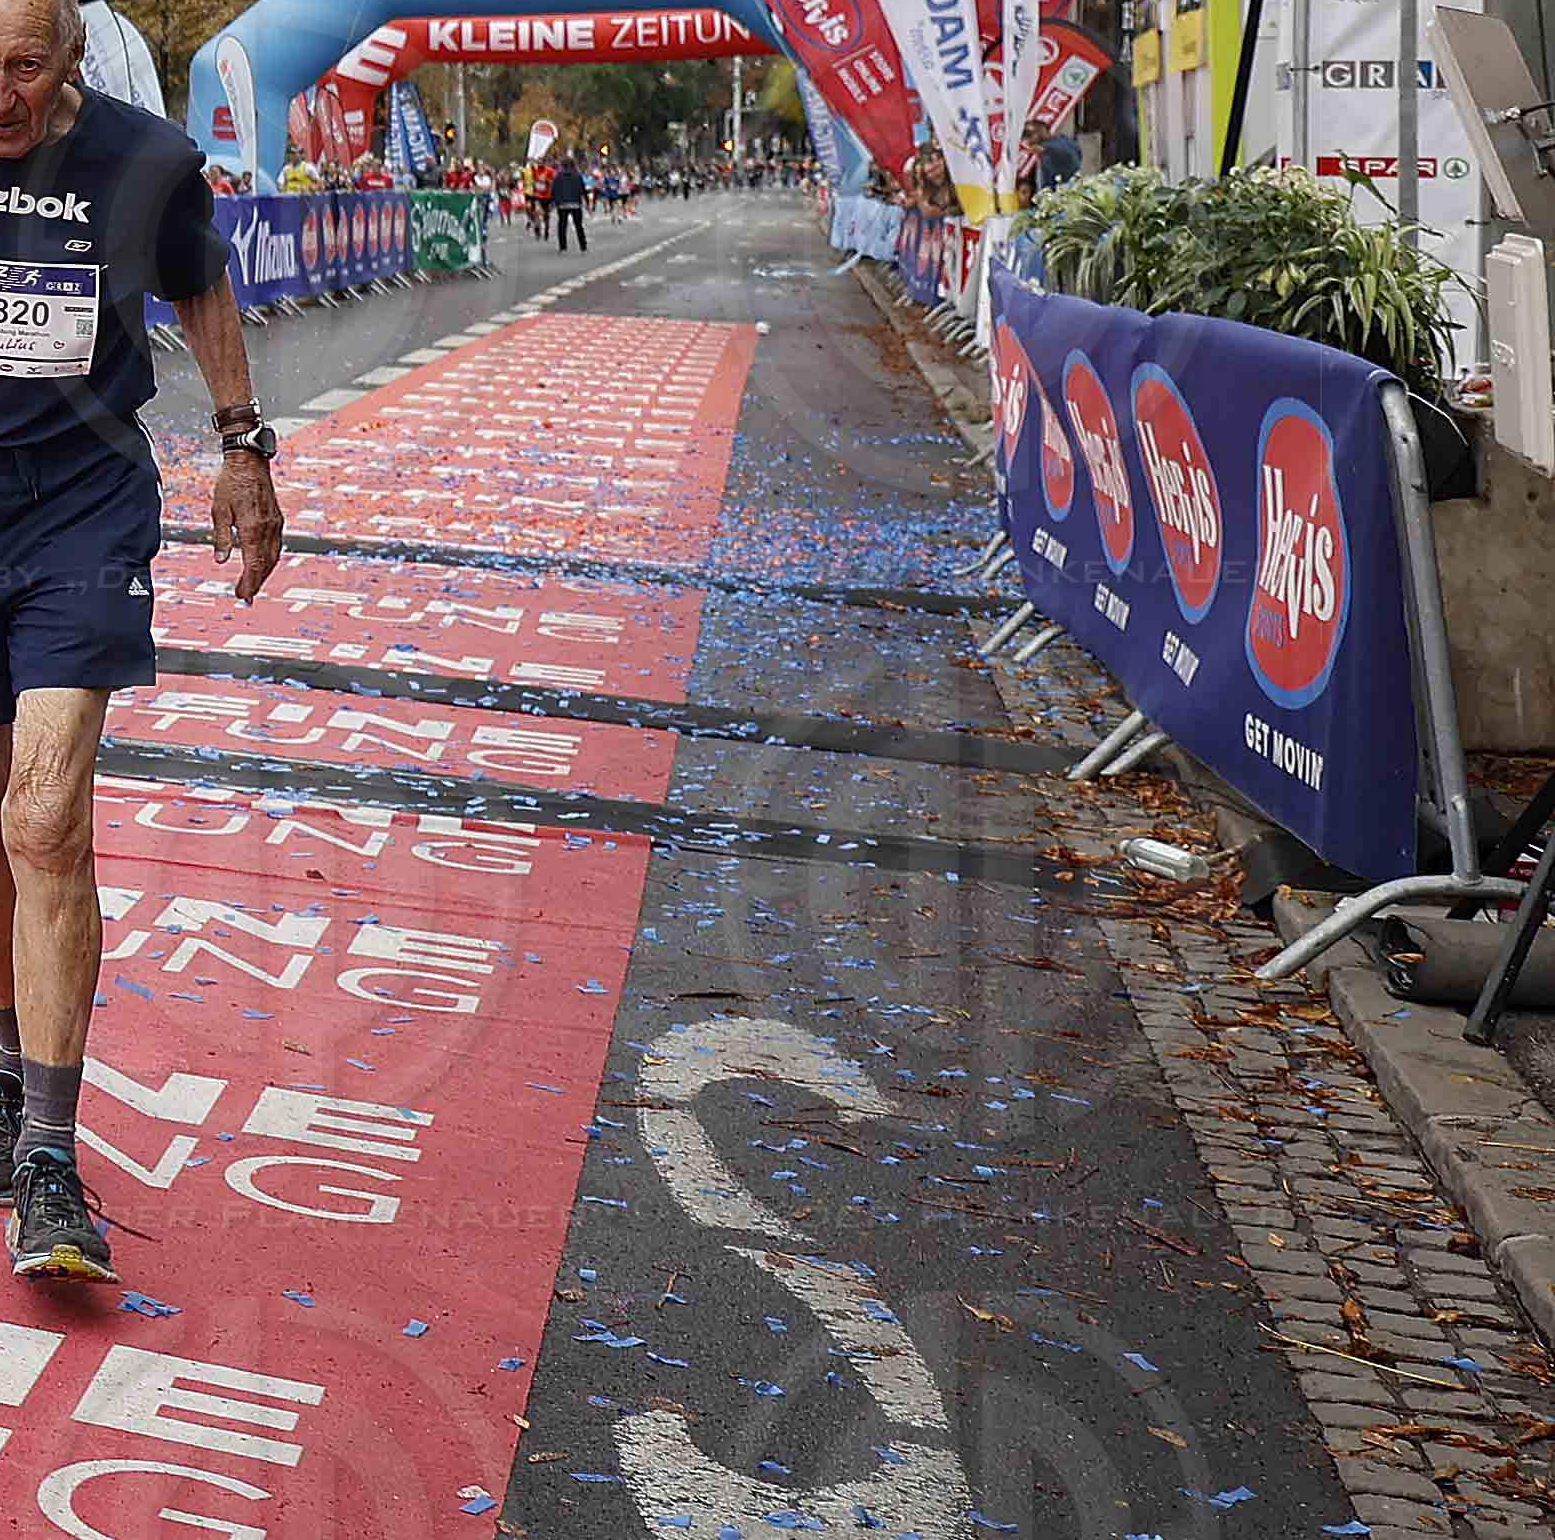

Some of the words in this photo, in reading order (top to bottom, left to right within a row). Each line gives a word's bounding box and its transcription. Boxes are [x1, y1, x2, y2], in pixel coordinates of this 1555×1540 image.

[428, 18, 594, 52] KLEINE
[611, 11, 753, 48] ZEITUN
[1138, 420, 1217, 565] Hervis
[1259, 464, 1335, 639] Hervis
[1245, 714, 1270, 760] GET
